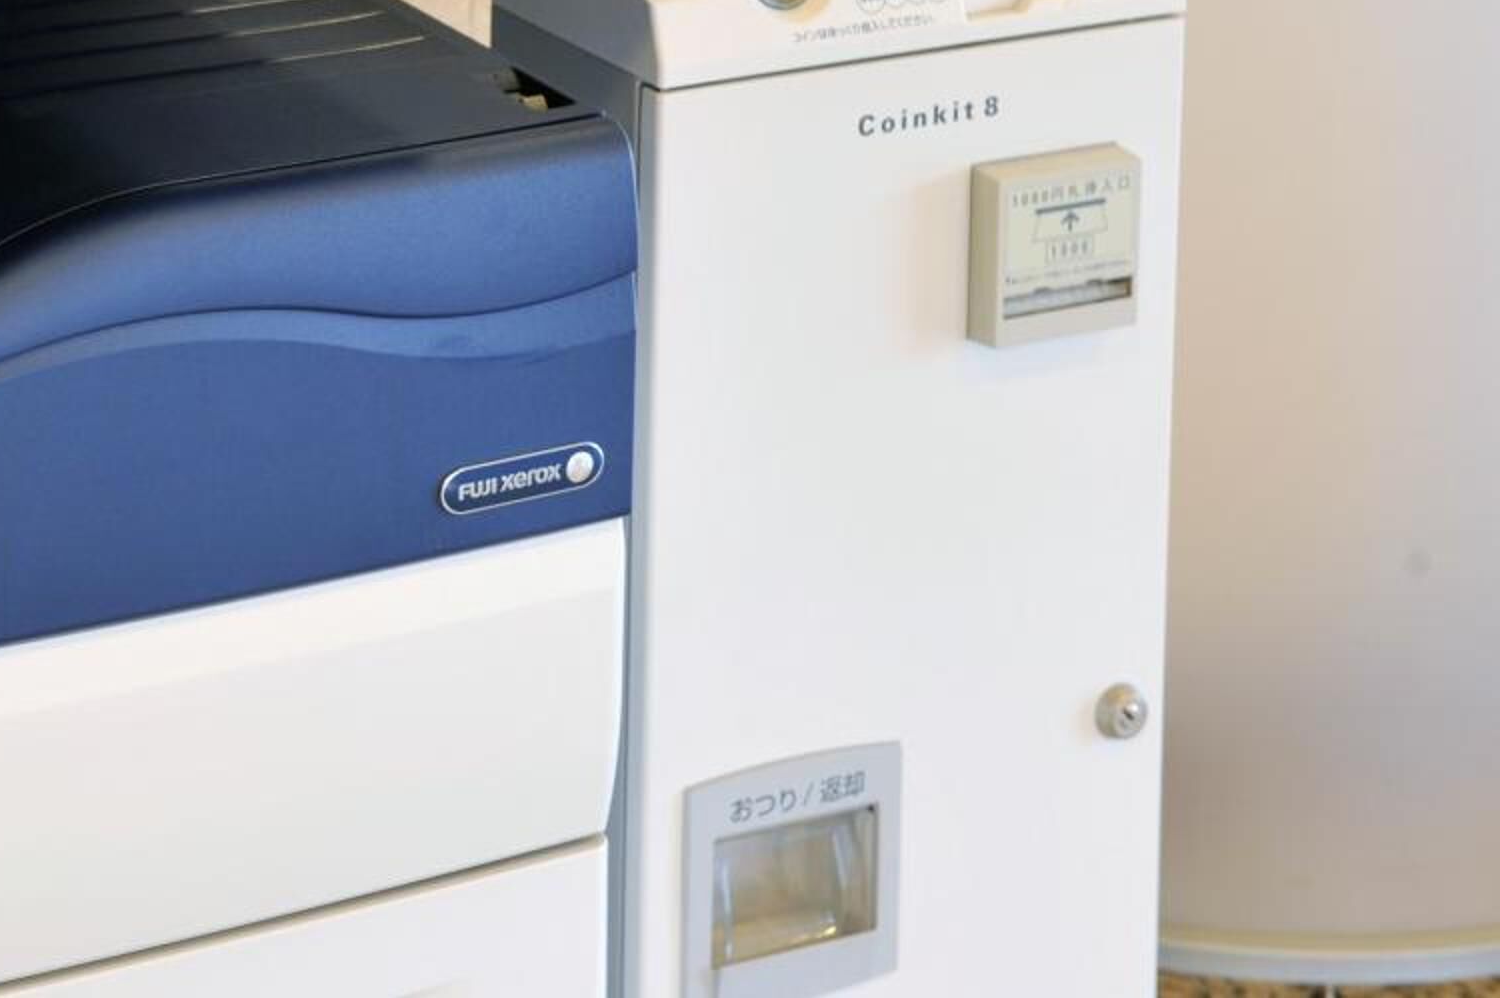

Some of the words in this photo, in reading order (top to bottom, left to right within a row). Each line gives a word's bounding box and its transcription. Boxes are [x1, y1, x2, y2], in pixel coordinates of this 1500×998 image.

[858, 101, 974, 137] Coinkit
[984, 96, 999, 117] 8
[457, 477, 498, 502] FUJI
[500, 463, 563, 493] xerox
